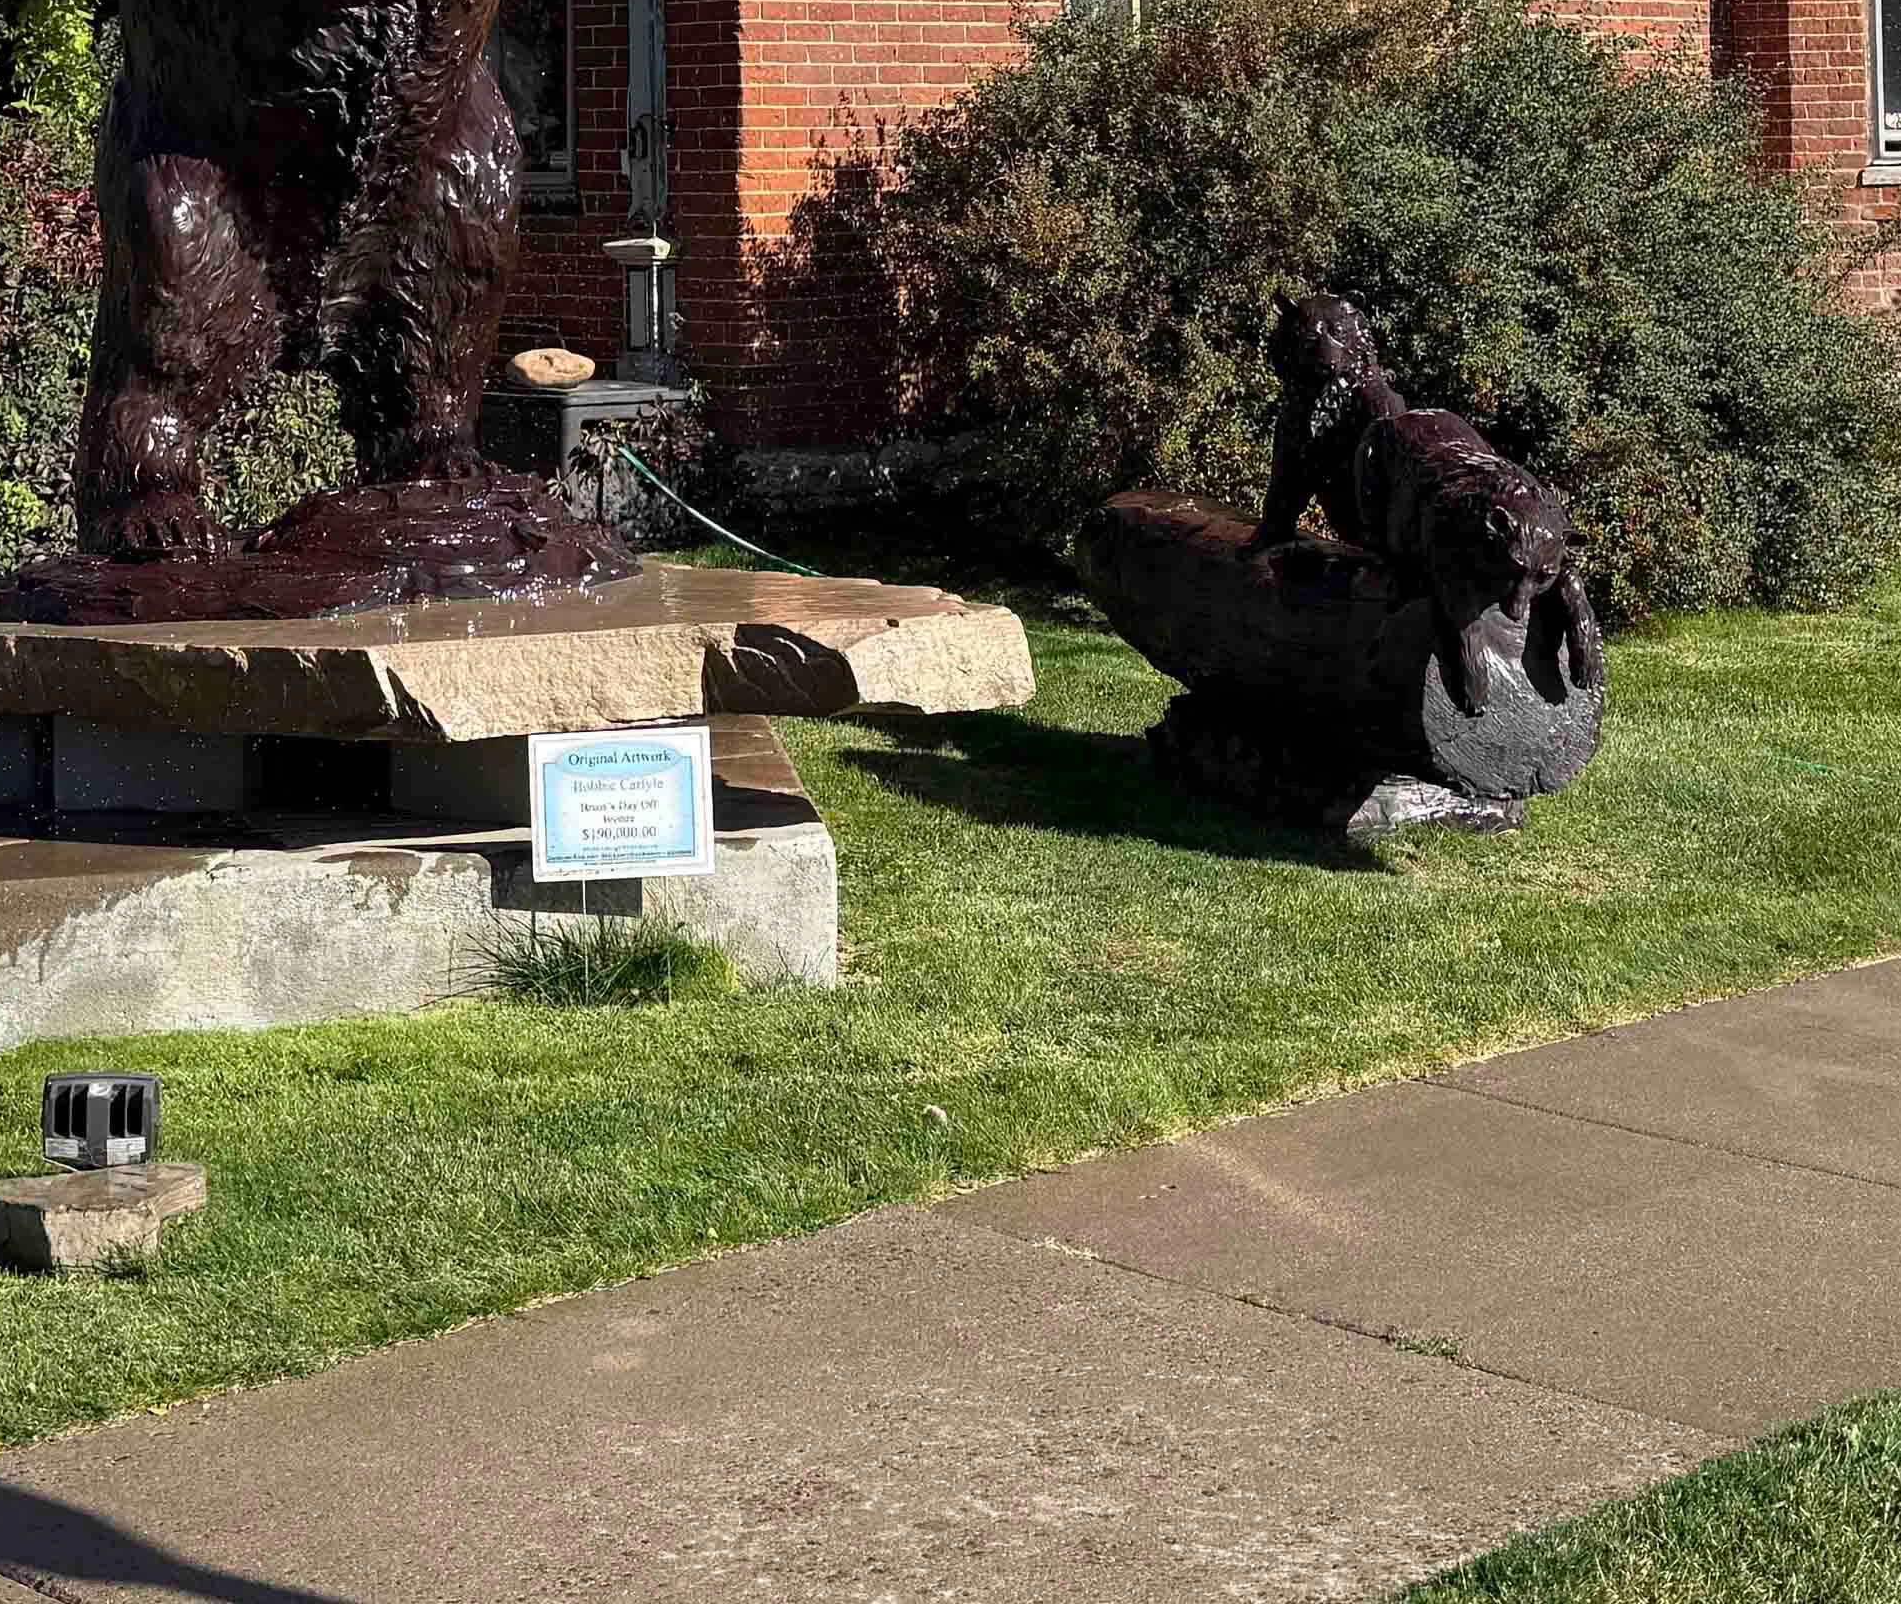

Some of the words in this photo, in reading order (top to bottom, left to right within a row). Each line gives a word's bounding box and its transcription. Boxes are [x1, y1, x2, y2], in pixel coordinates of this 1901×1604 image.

[568, 750, 618, 767] Original
[621, 749, 672, 763] Artwork
[582, 827, 657, 841] $190,000.00
